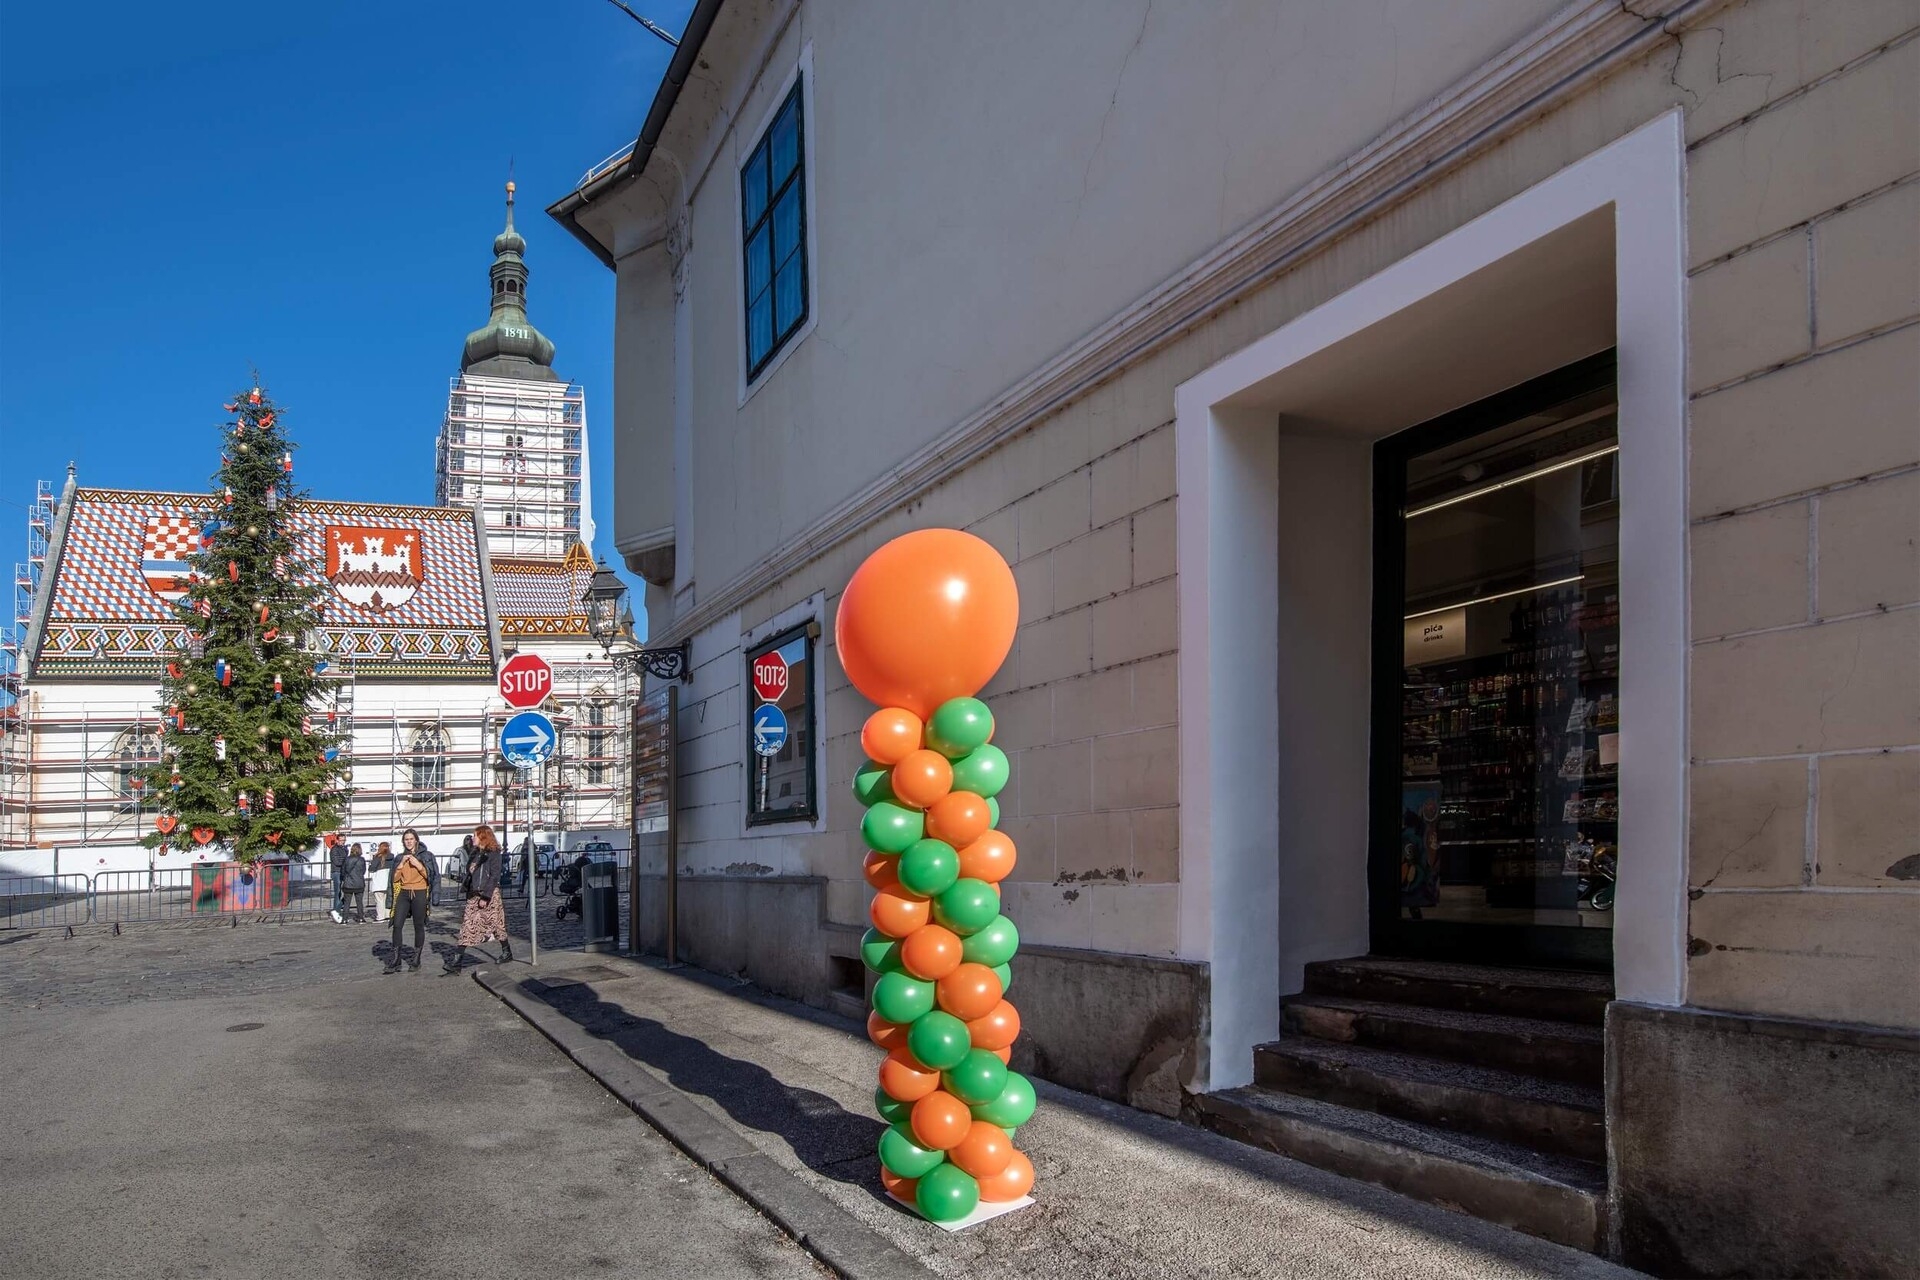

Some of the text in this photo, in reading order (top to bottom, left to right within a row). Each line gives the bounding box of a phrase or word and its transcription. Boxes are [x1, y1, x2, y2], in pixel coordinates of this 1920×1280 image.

[1424, 624, 1443, 636] pića
[1424, 634, 1443, 643] drinks
[502, 668, 549, 694] STOP
